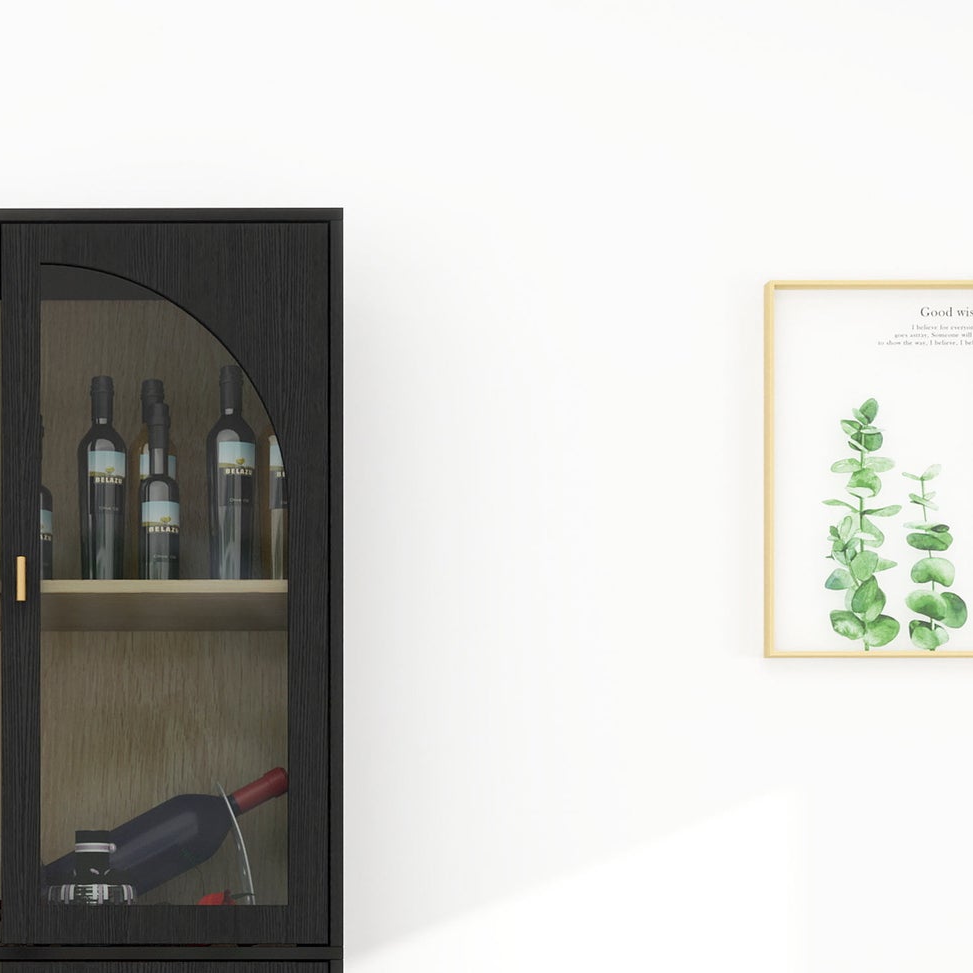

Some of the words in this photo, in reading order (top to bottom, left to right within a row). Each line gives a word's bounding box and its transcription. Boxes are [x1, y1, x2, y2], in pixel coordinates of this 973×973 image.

[920, 306, 953, 318] Good
[225, 468, 253, 476] BELAZU
[95, 476, 124, 484] BELAZU
